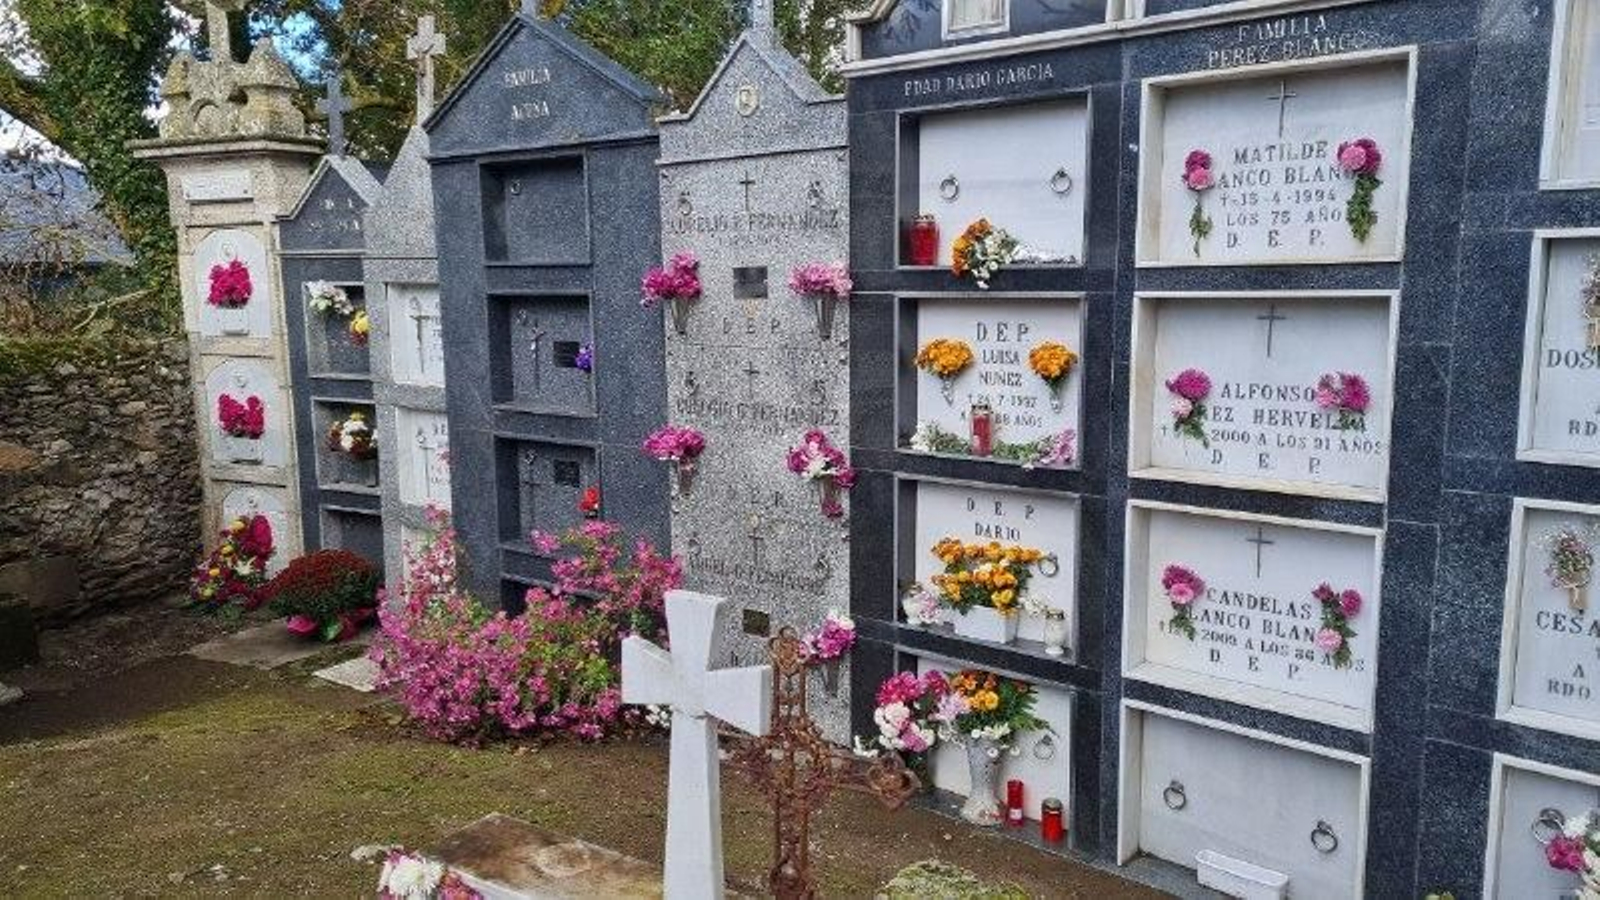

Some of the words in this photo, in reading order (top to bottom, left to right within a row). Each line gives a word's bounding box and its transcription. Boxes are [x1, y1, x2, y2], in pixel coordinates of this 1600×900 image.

[1238, 15, 1327, 42] FAMILIA
[1208, 43, 1270, 68] PEREZ
[1283, 31, 1366, 60] BLANCO
[947, 71, 990, 91] DARIO
[997, 63, 1054, 85] GARCIA
[1234, 141, 1328, 164] MATILDE
[1218, 168, 1271, 188] ANCO
[1285, 166, 1341, 185] BLAN
[1227, 213, 1258, 226] LOS
[1271, 210, 1290, 225] 75
[1305, 205, 1341, 223] AÑO
[983, 349, 1020, 365] LUISA
[1546, 349, 1600, 369] DOS
[1221, 383, 1316, 402] ALFONSO
[1568, 419, 1599, 436] RD
[1211, 429, 1251, 444] 2000
[1258, 433, 1267, 447] A
[1277, 434, 1306, 450] LOS
[1314, 437, 1330, 450] 91
[975, 522, 1020, 541] DARIO
[1206, 587, 1312, 620] CANDELAS
[1188, 605, 1250, 630] LANCO
[1262, 618, 1315, 644] BLAN
[1245, 638, 1254, 650] A
[1260, 640, 1289, 658] LOS
